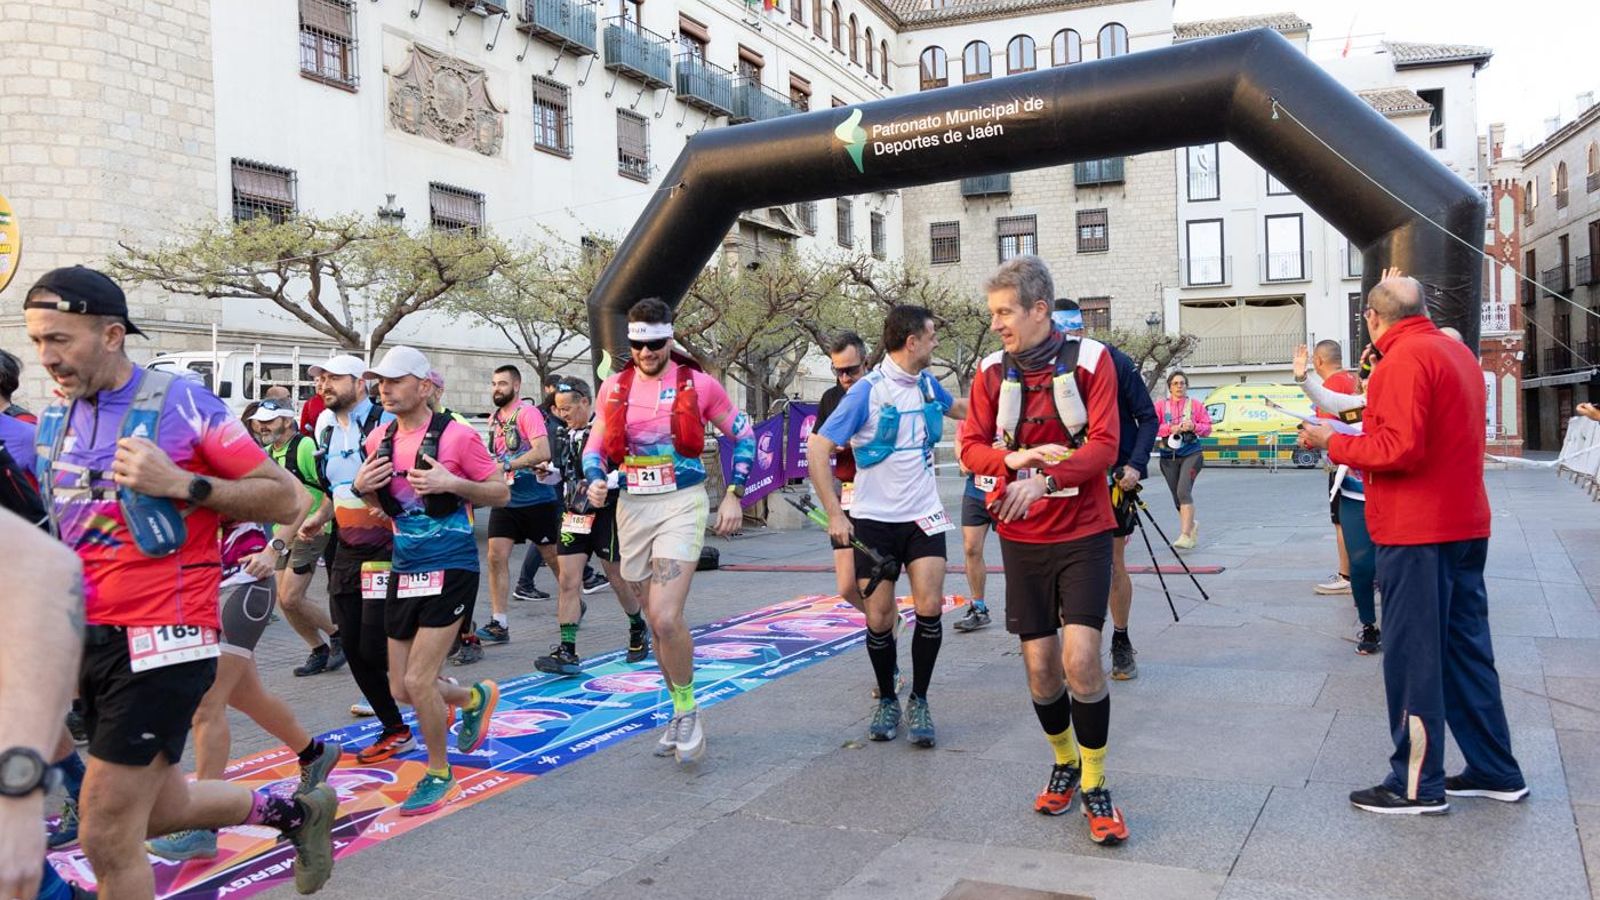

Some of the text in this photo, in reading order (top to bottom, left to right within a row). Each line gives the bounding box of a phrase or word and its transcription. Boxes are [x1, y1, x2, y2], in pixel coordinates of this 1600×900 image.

[872, 97, 1044, 138] Patronato Municipal de
[873, 121, 1004, 156] Deportes de Jaén
[641, 471, 656, 481] 21
[982, 477, 994, 485] 34
[157, 625, 200, 641] 165
